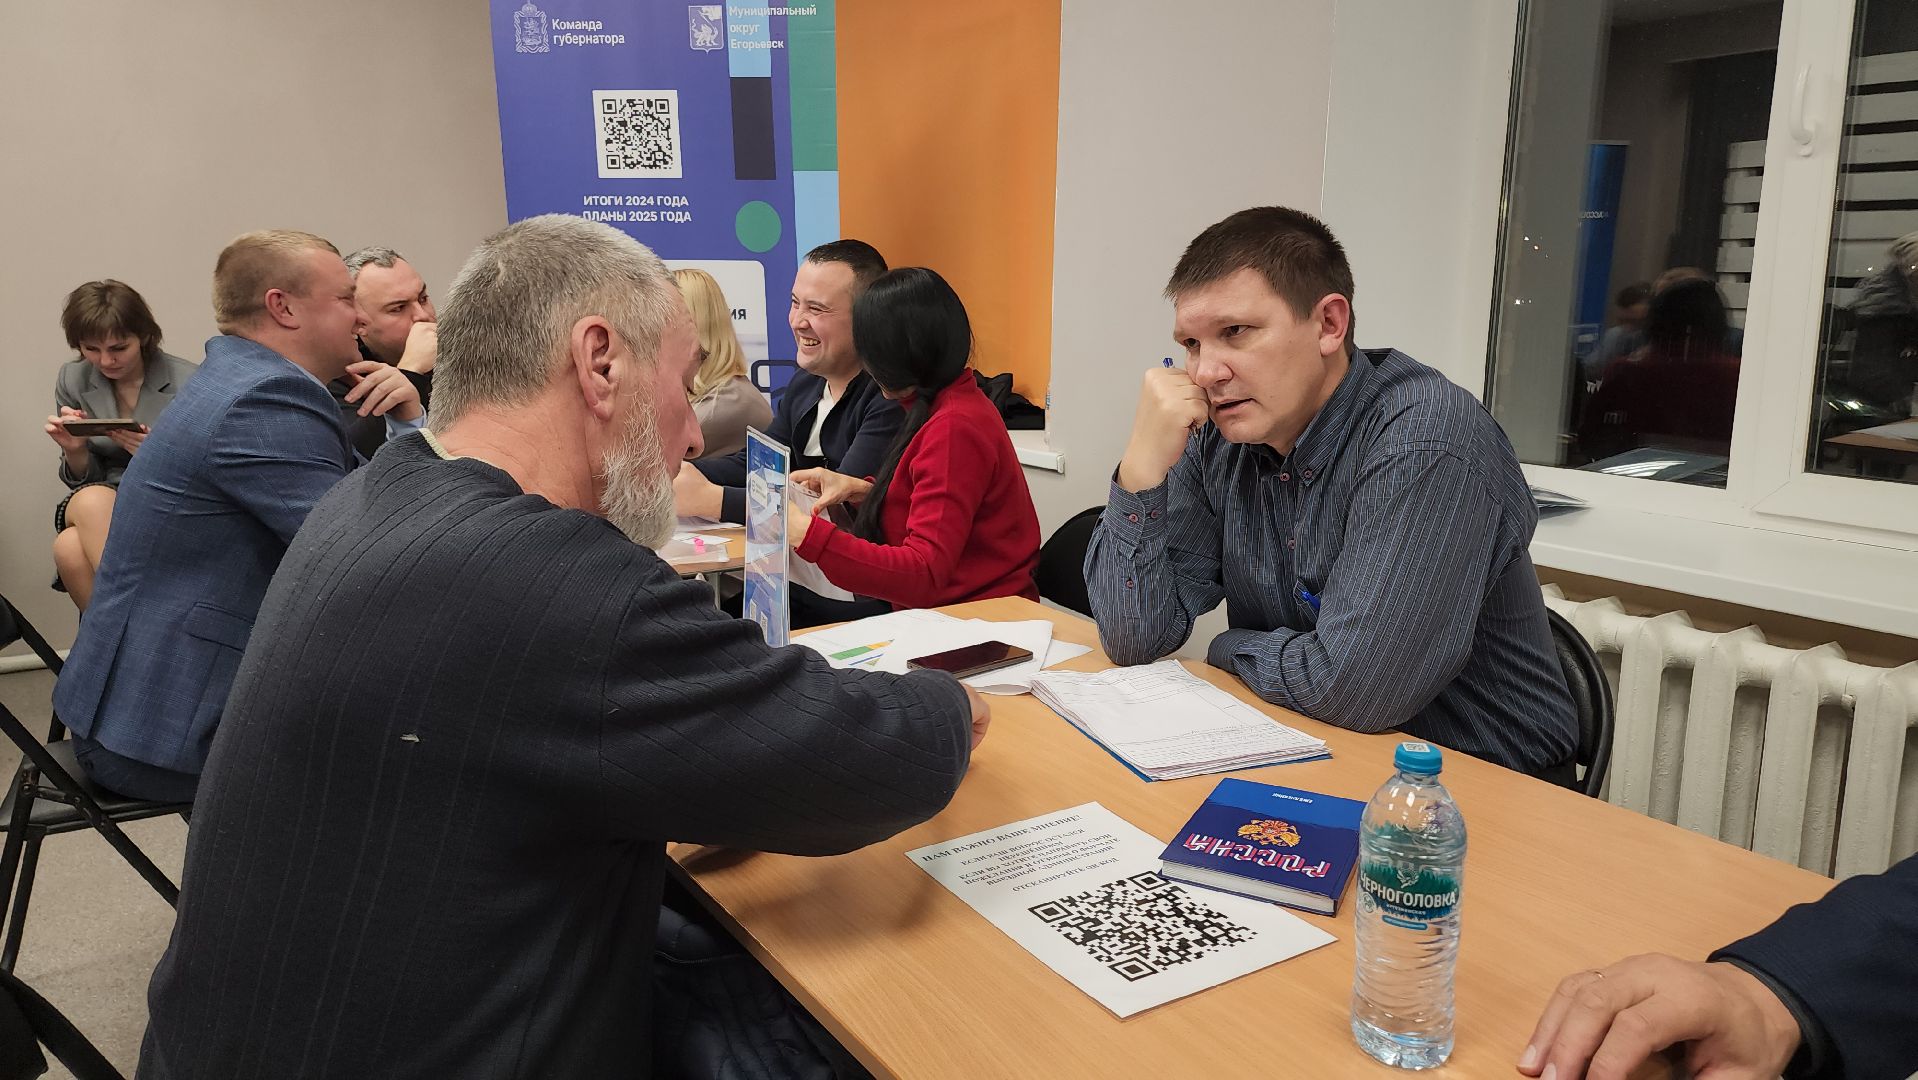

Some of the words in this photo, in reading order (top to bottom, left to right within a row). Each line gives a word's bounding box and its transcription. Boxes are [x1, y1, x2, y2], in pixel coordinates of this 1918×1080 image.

[728, 4, 817, 18] Муниципальный
[551, 18, 603, 31] Команда
[730, 24, 760, 35] округ
[553, 32, 625, 46] губернатора
[730, 38, 785, 51] Егорьевск
[583, 195, 623, 206] ИТОГИ
[625, 195, 655, 206] 2024
[656, 196, 689, 208] ГОДА
[582, 210, 627, 222] ПЛАНЫ
[628, 211, 658, 222] 2025
[660, 211, 692, 223] ГОДА
[922, 850, 952, 861] НАМ
[951, 839, 995, 853] ВАЖНО
[996, 829, 1031, 841] ВАШЕ
[1030, 815, 1082, 831] МНЕНИЕ!
[961, 855, 987, 865] ЕСЛИ
[986, 850, 1009, 858] ВАШ
[1009, 840, 1043, 852] ВОПРОС
[1182, 832, 1331, 878] РОССИЯ
[958, 870, 986, 880] ЕСЛИ
[964, 865, 1024, 885] ПОЖЕЛАНИЯ
[1012, 867, 1085, 891] ОТСКАНИРУЙТЕ
[1360, 871, 1456, 908] ЧЕРНОГОЛОВКА
